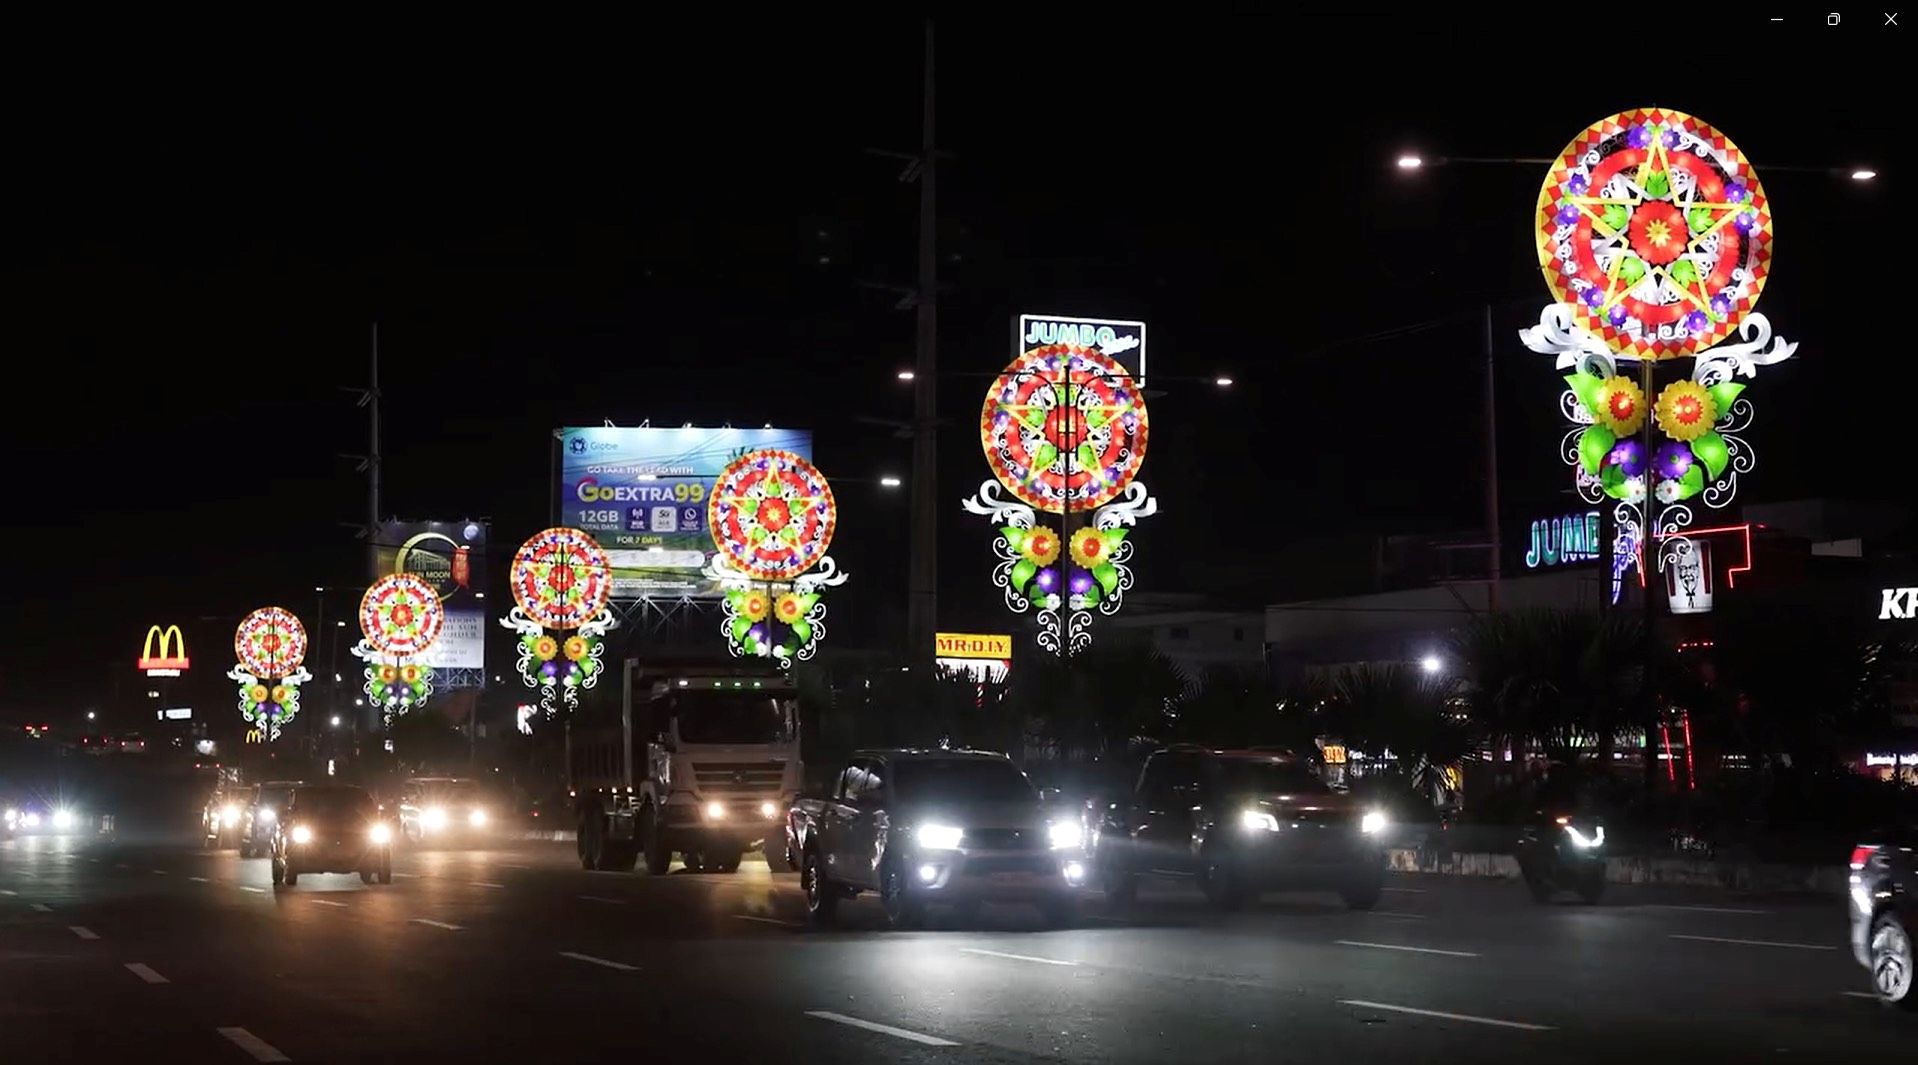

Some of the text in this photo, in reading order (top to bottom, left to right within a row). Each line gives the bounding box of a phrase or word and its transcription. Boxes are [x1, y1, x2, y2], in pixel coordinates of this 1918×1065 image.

[1025, 321, 1116, 347] JUMBO
[590, 440, 619, 451] Globe
[668, 466, 694, 474] WITH
[578, 510, 619, 523] 12GB
[616, 536, 634, 545] FOR
